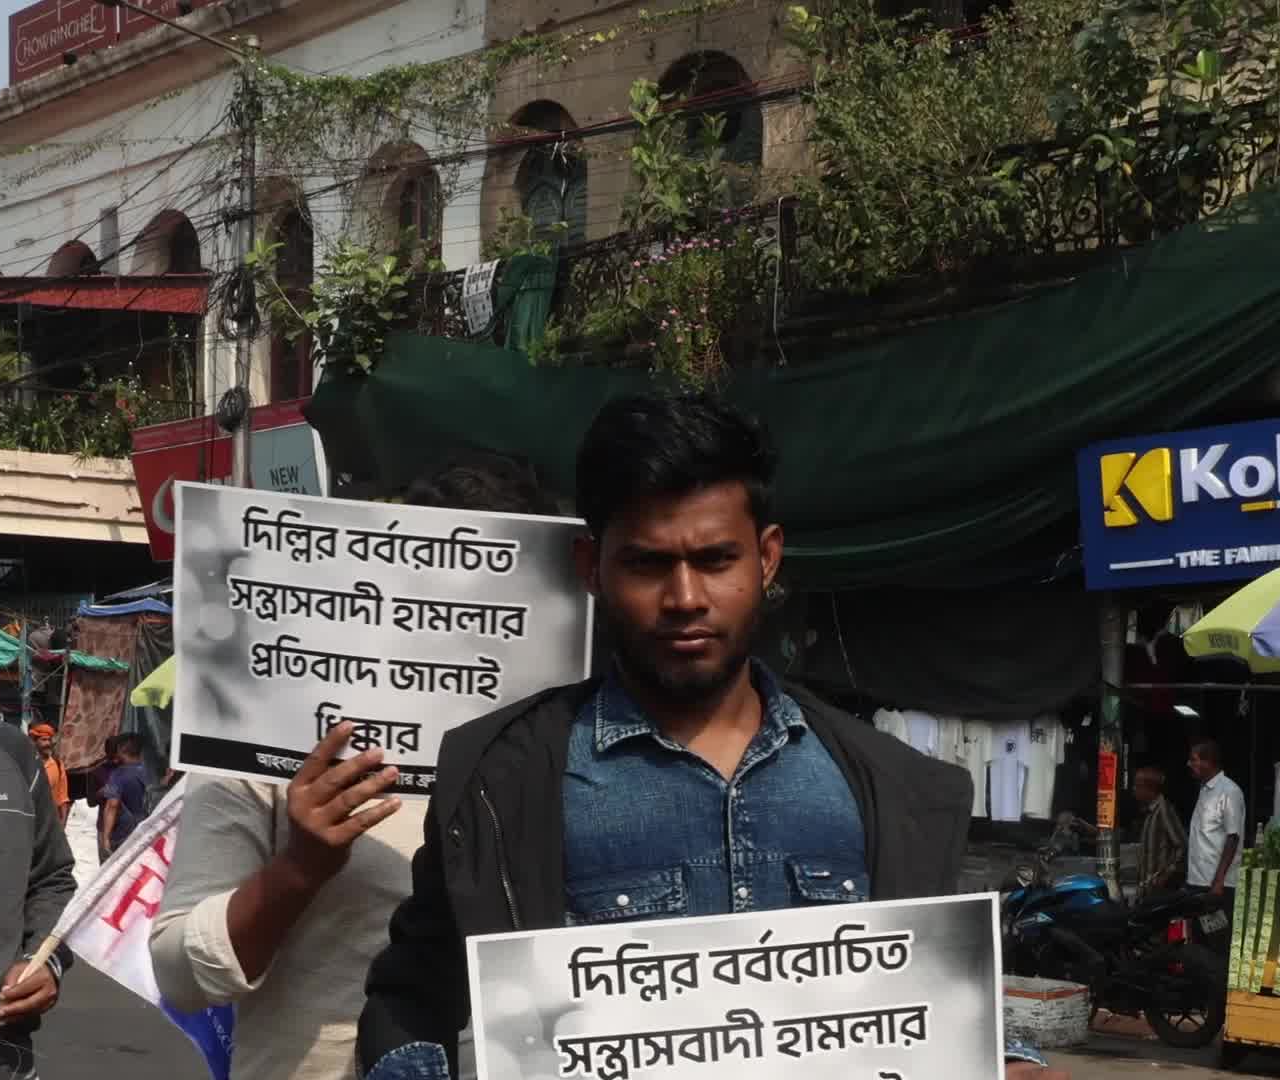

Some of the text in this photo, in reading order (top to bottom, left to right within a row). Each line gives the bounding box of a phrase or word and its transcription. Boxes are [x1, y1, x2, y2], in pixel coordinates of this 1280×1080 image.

[269, 465, 300, 487] NEW
[242, 506, 517, 573] দিল্লির বর্বরোচিত
[1175, 548, 1221, 569] THE
[229, 576, 528, 640] সন্ত্রাসবাদী হামলার
[250, 634, 500, 700] প্রতিবাদে জানাই
[568, 924, 911, 1002] দিল্লির বর্বরোচিত
[557, 1004, 929, 1080] সন্ত্রাসবাদী হামলার
